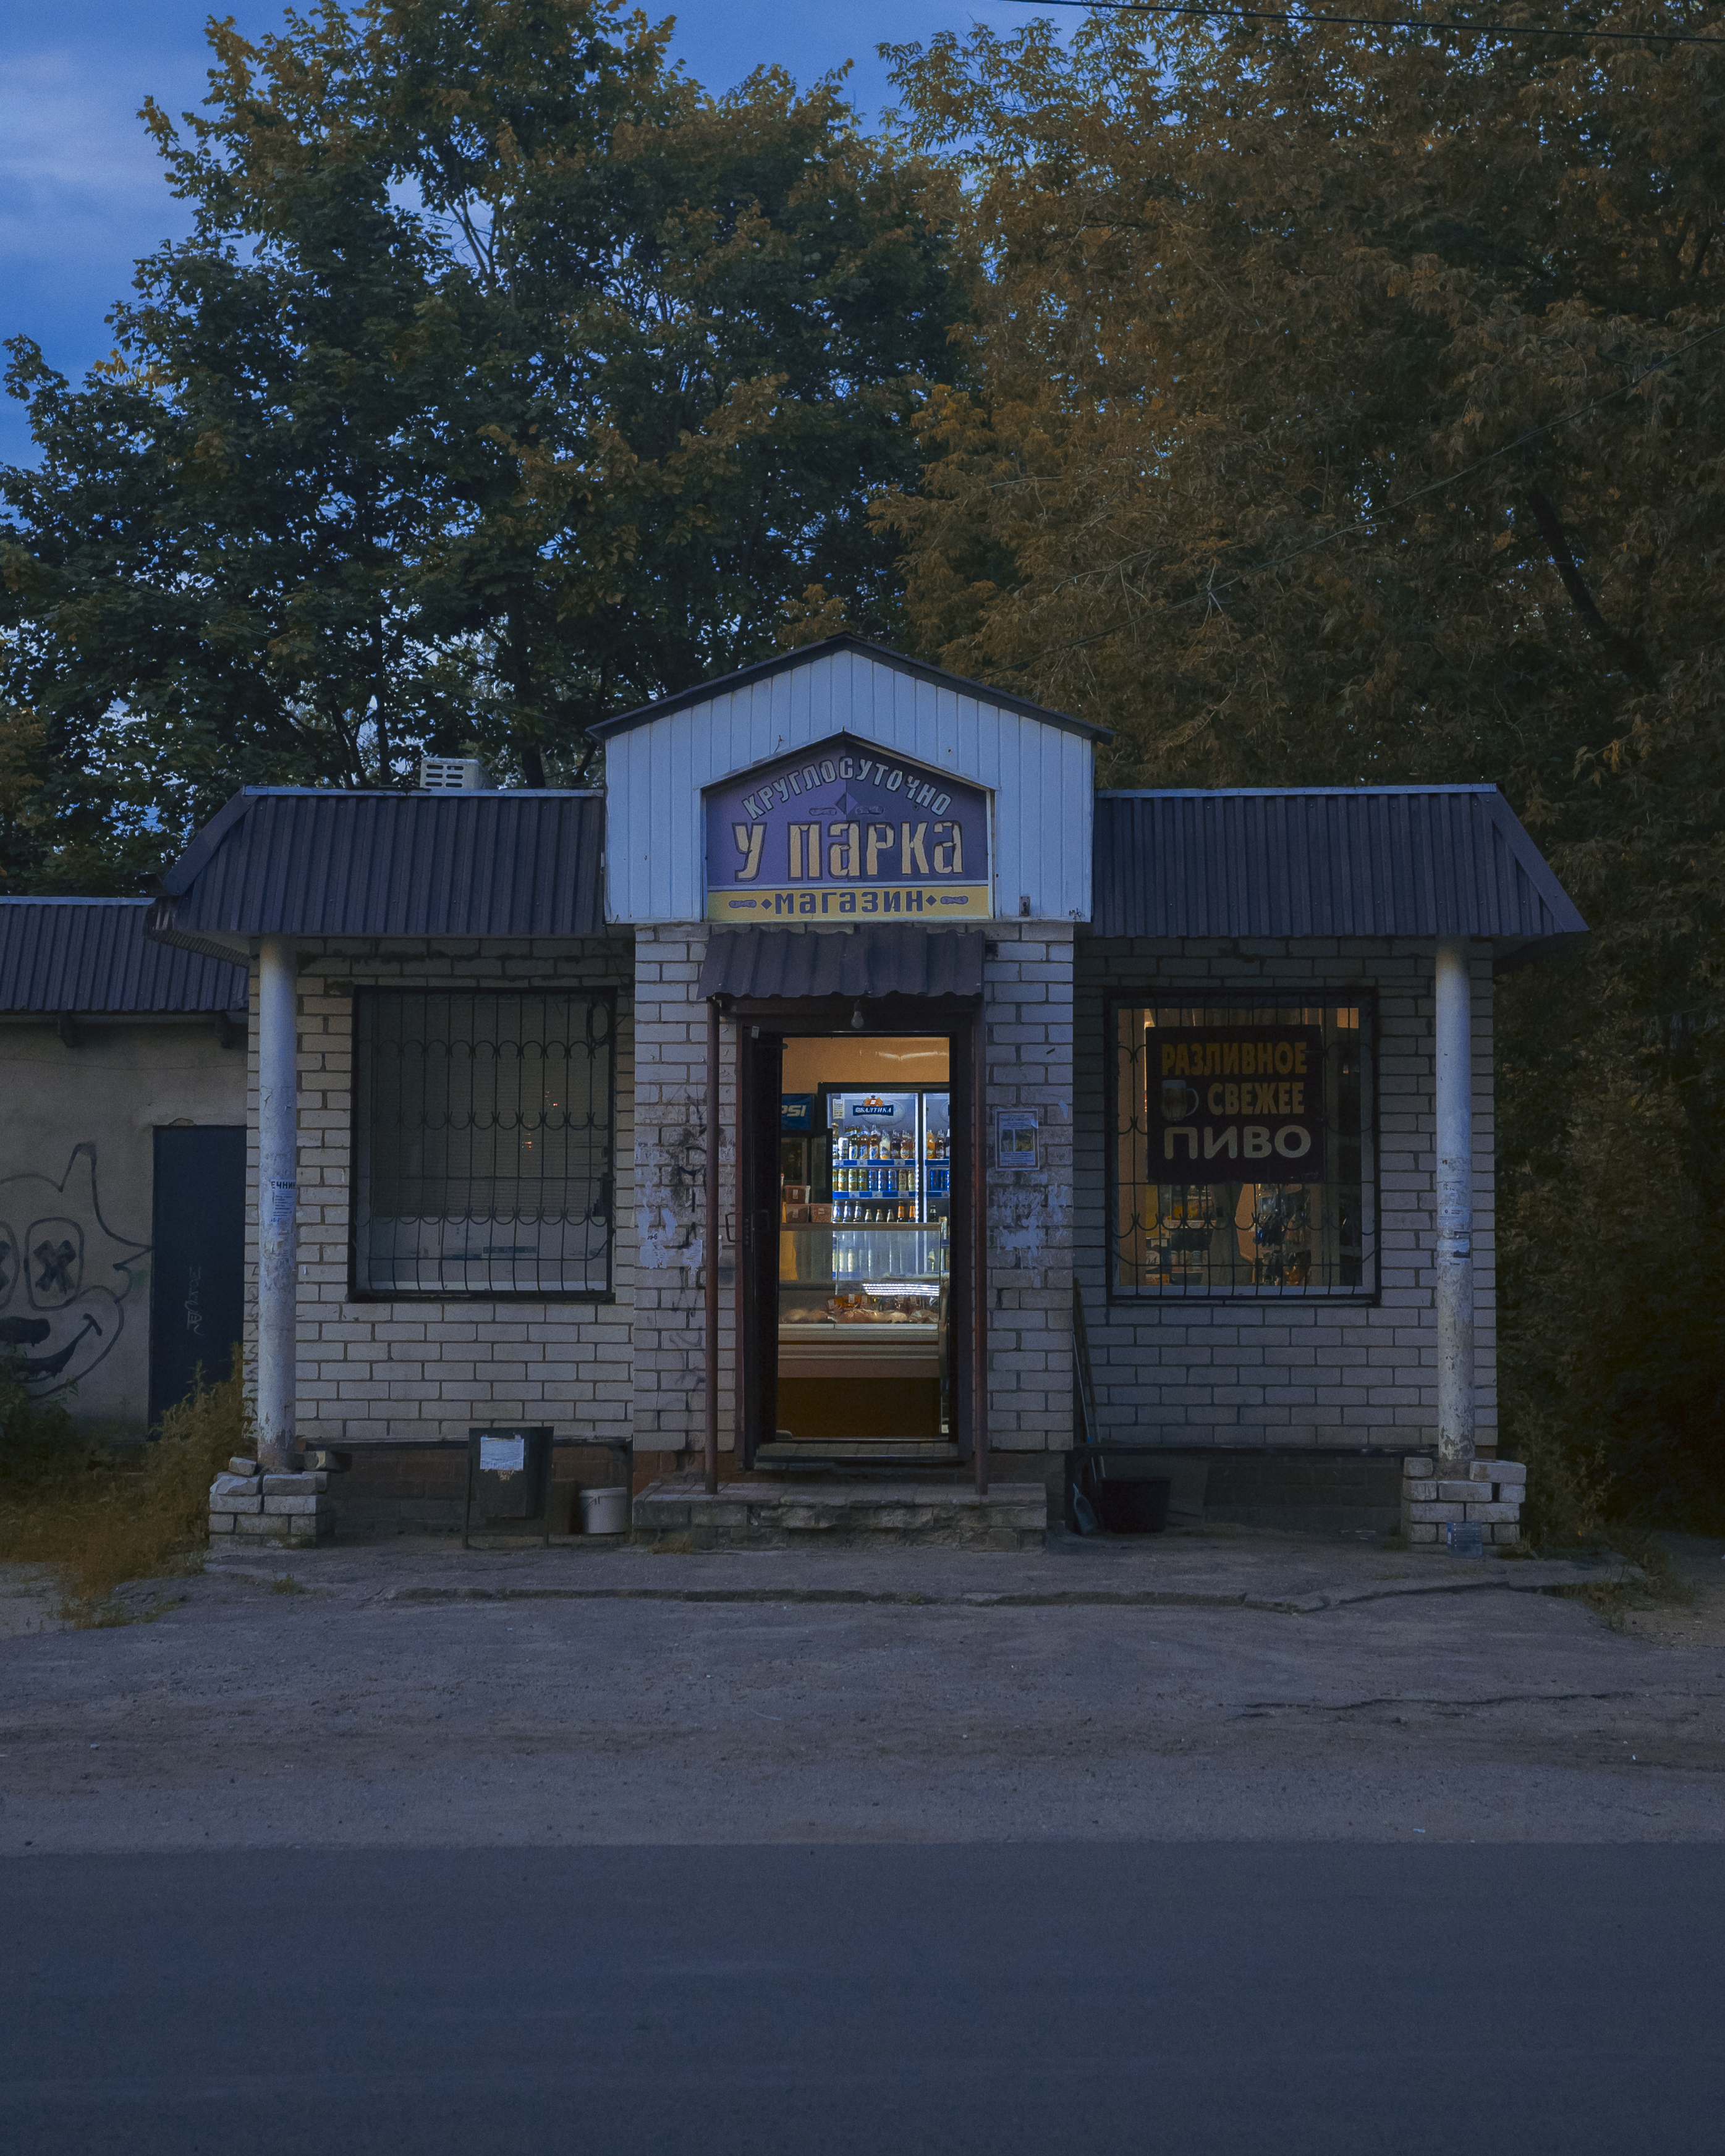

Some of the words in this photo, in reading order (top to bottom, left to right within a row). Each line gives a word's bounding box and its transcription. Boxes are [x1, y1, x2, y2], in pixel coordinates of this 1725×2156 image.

[743, 757, 952, 820] КРУГЛОСУТОЧНО
[732, 822, 767, 882] У
[787, 820, 964, 881] ПАРКА
[1161, 1041, 1308, 1076] РАЗЛИВНОЕ
[1208, 1082, 1305, 1115] СВЕЖЕЕ
[1164, 1125, 1312, 1160] ПИВО
